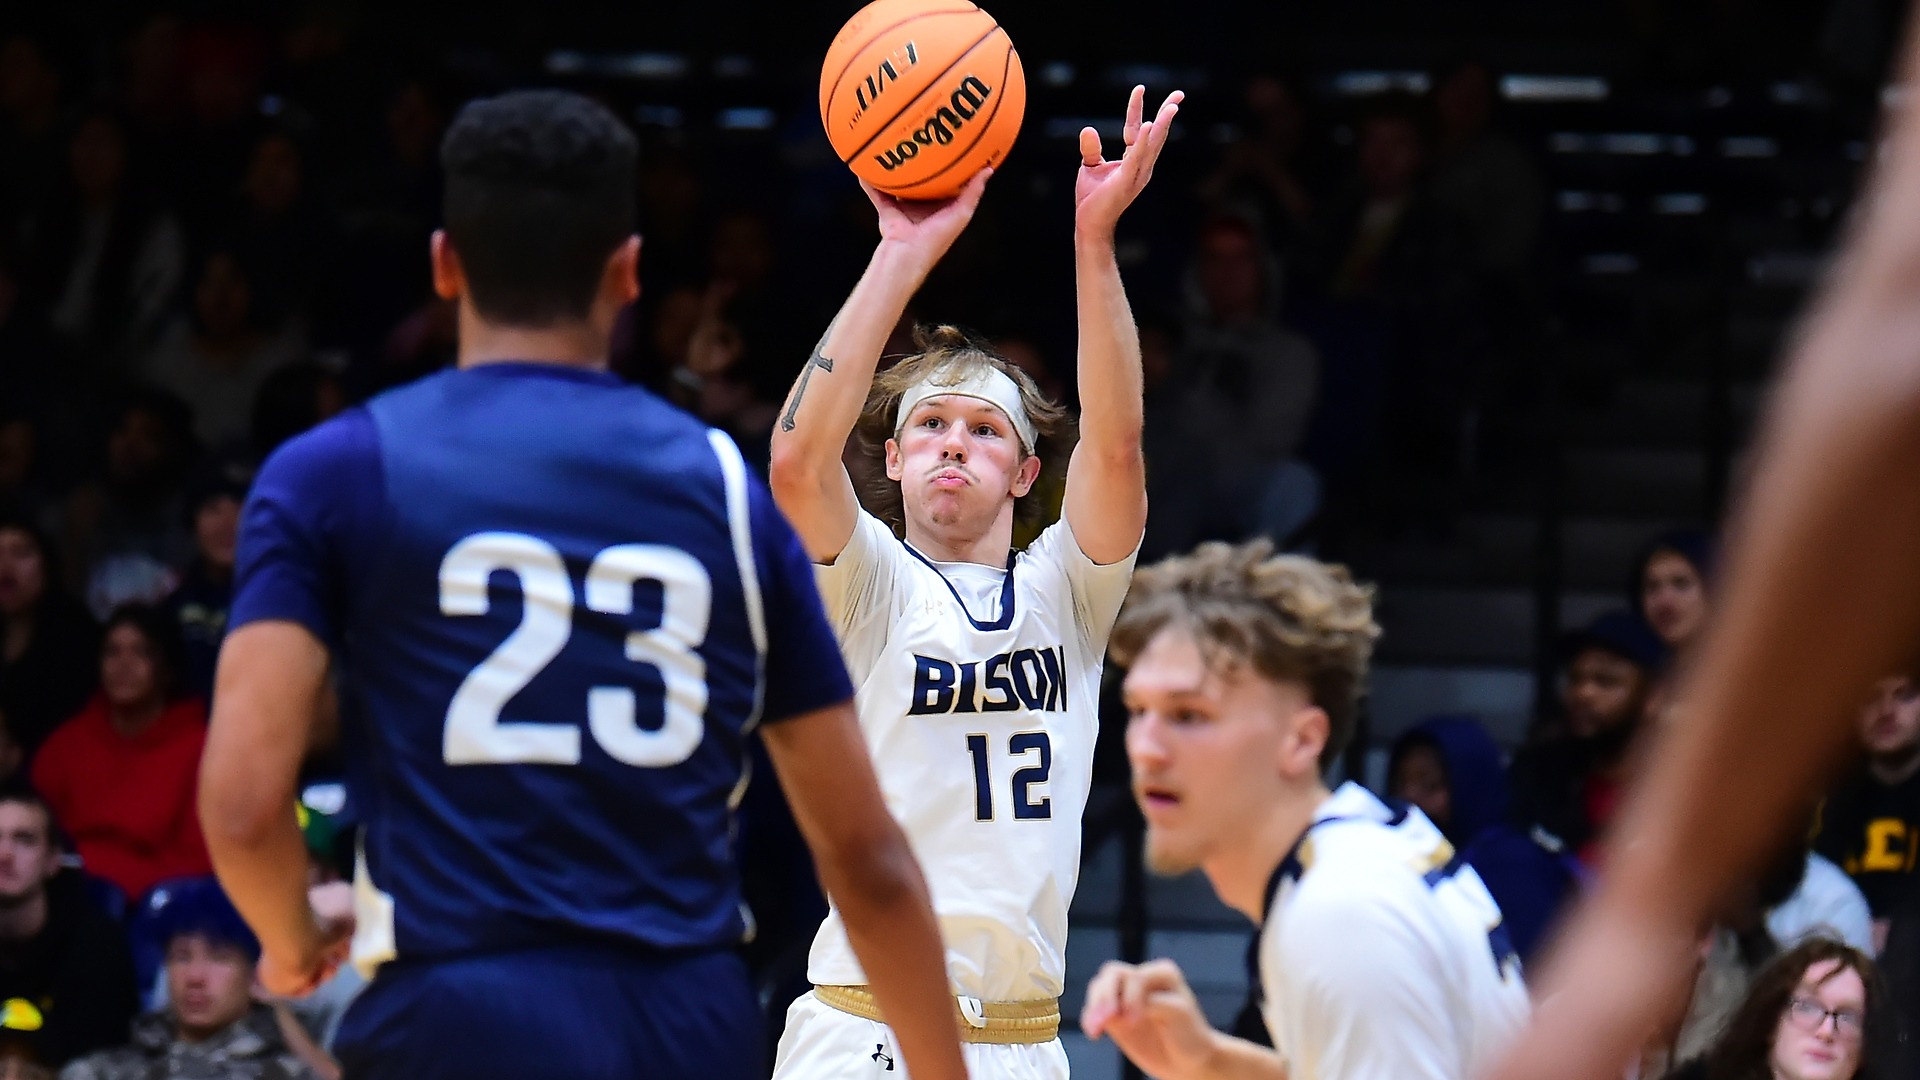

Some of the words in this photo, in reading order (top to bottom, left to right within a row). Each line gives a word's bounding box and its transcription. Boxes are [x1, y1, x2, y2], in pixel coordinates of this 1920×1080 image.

[855, 39, 919, 112] EVO
[874, 75, 992, 171] Wilson
[438, 530, 713, 768] 23
[905, 644, 1068, 716] BISON
[965, 729, 1052, 822] 12
